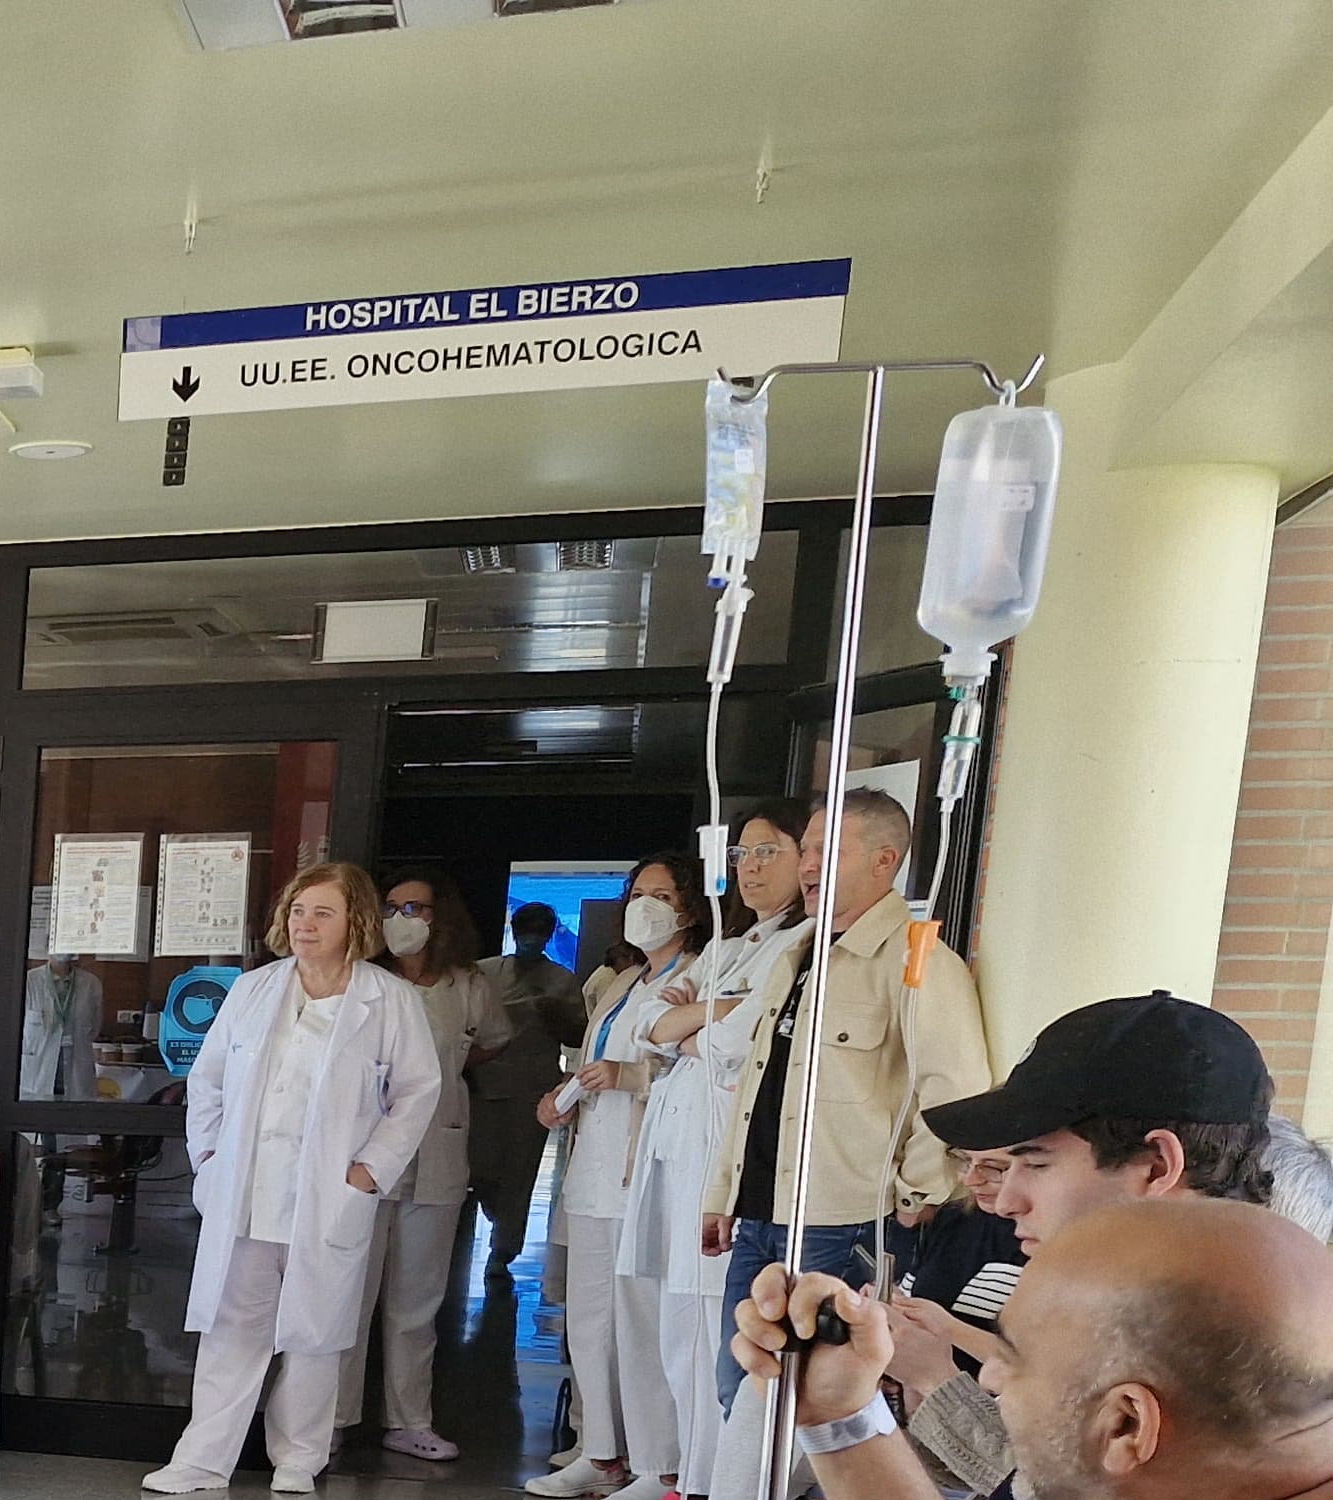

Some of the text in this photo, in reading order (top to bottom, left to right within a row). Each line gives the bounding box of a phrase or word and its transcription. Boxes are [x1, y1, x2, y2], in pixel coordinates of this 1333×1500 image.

[306, 281, 639, 331] HOSPITAL EL BIERZO
[240, 329, 703, 390] UU.EE. ONCOHEMATOLOGICA
